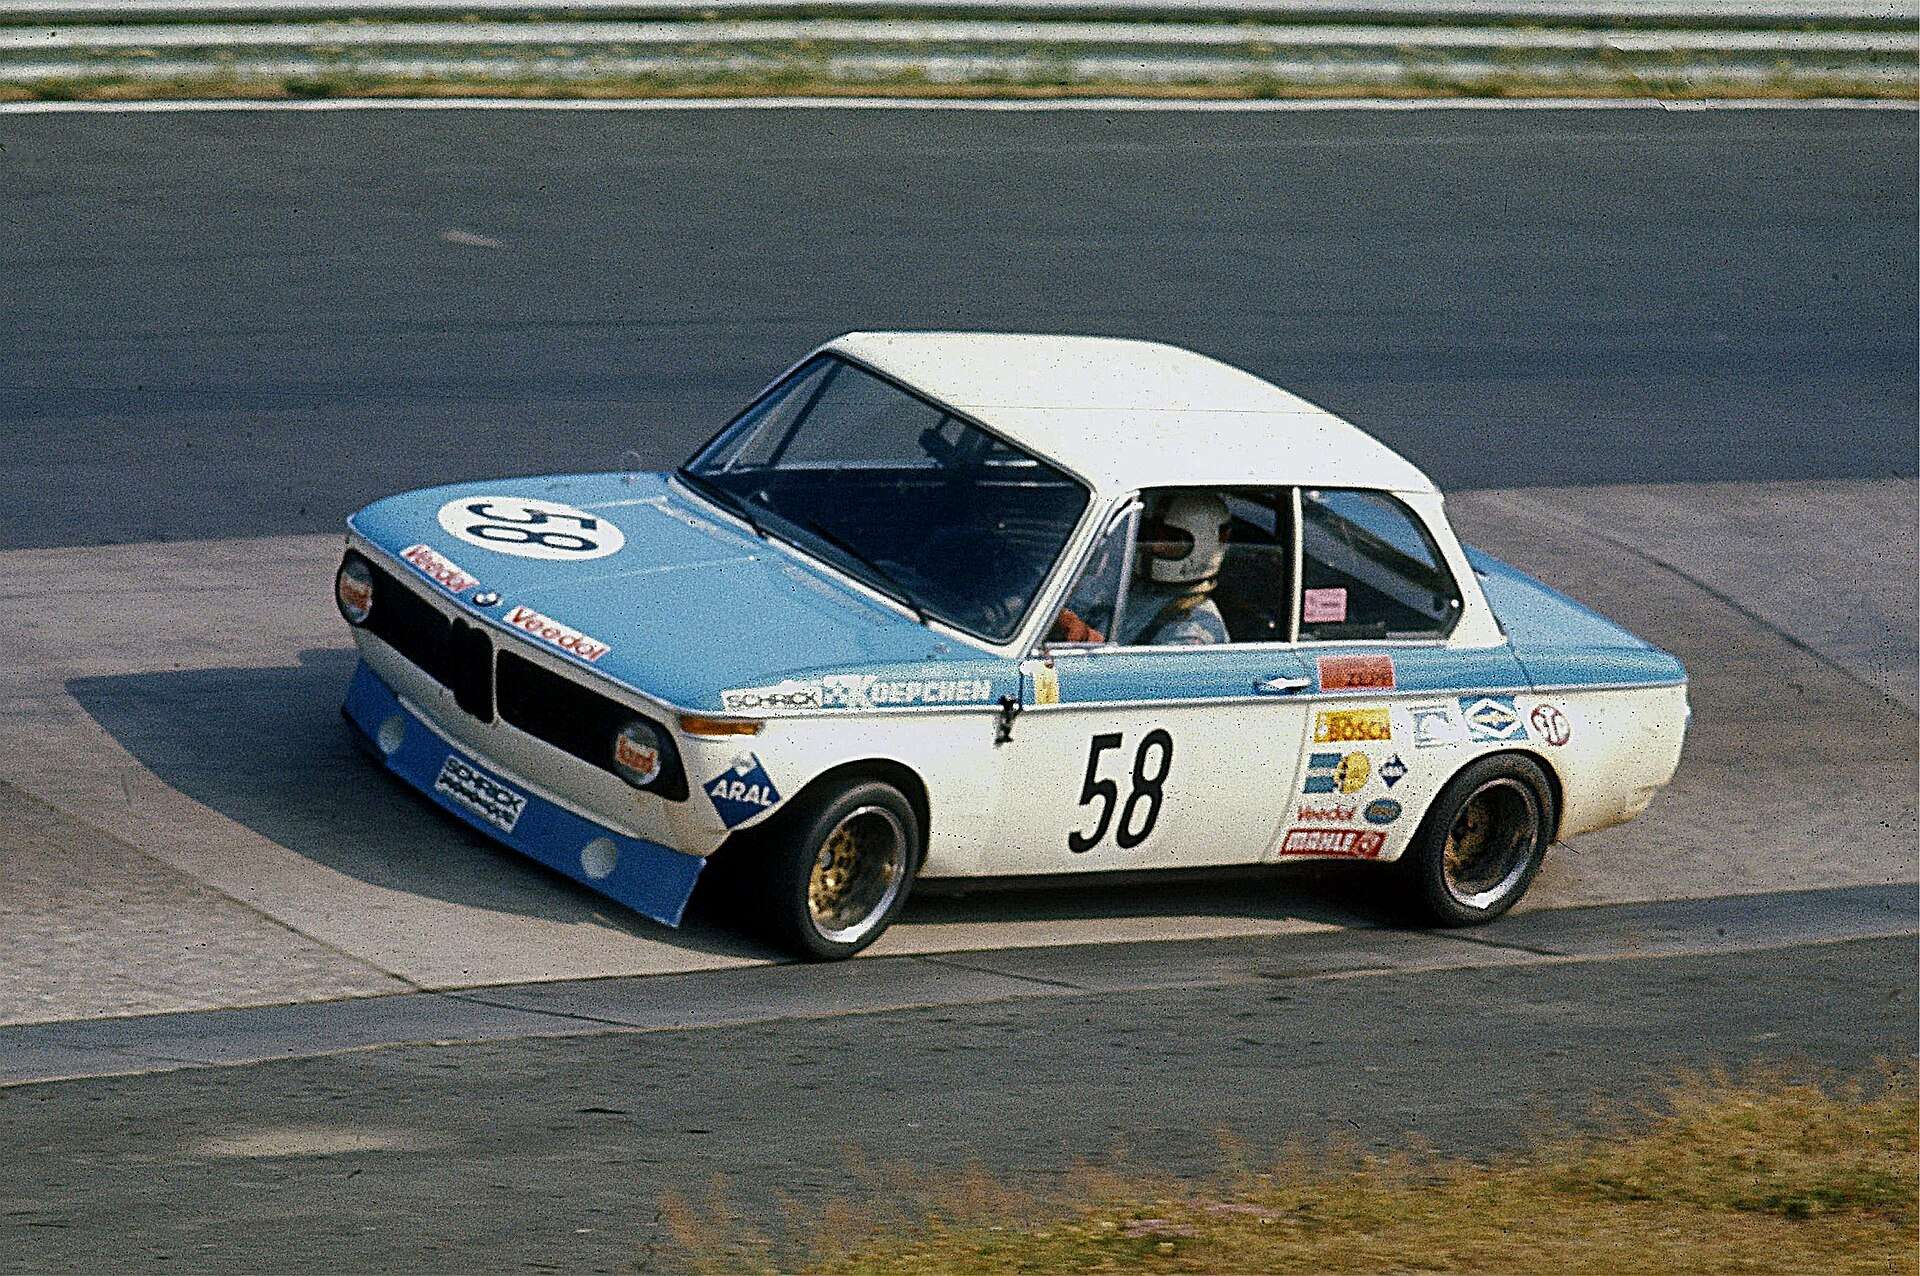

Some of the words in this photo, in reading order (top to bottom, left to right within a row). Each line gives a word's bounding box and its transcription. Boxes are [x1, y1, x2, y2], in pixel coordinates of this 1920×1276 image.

[466, 504, 599, 551] 58
[513, 607, 606, 660] Veedol
[727, 691, 820, 709] SCHRICK
[711, 779, 772, 806] ARAL
[1068, 728, 1173, 853] 58
